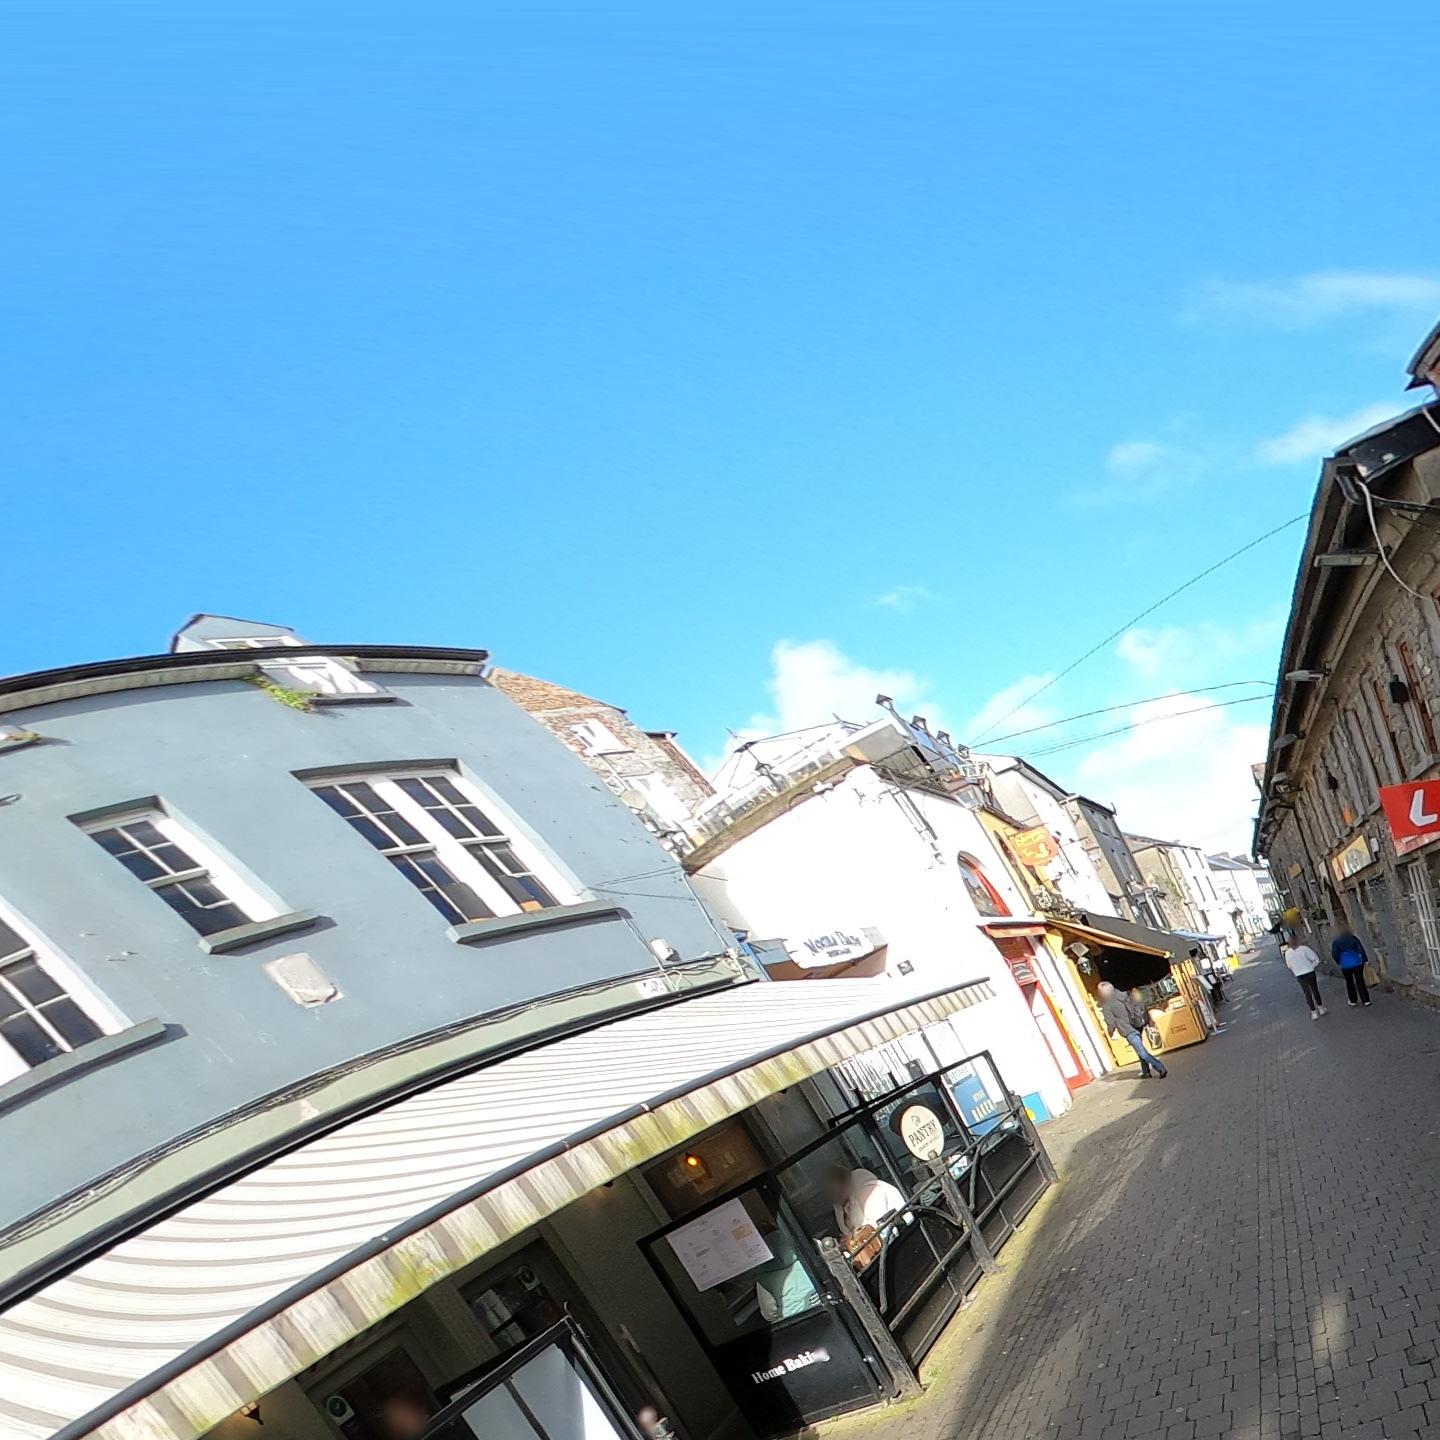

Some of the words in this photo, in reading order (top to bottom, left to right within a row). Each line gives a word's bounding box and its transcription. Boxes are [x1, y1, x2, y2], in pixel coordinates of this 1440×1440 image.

[907, 1119, 939, 1148] PANTRY
[751, 1365, 787, 1384] Home
[783, 1349, 830, 1372] Bakin
